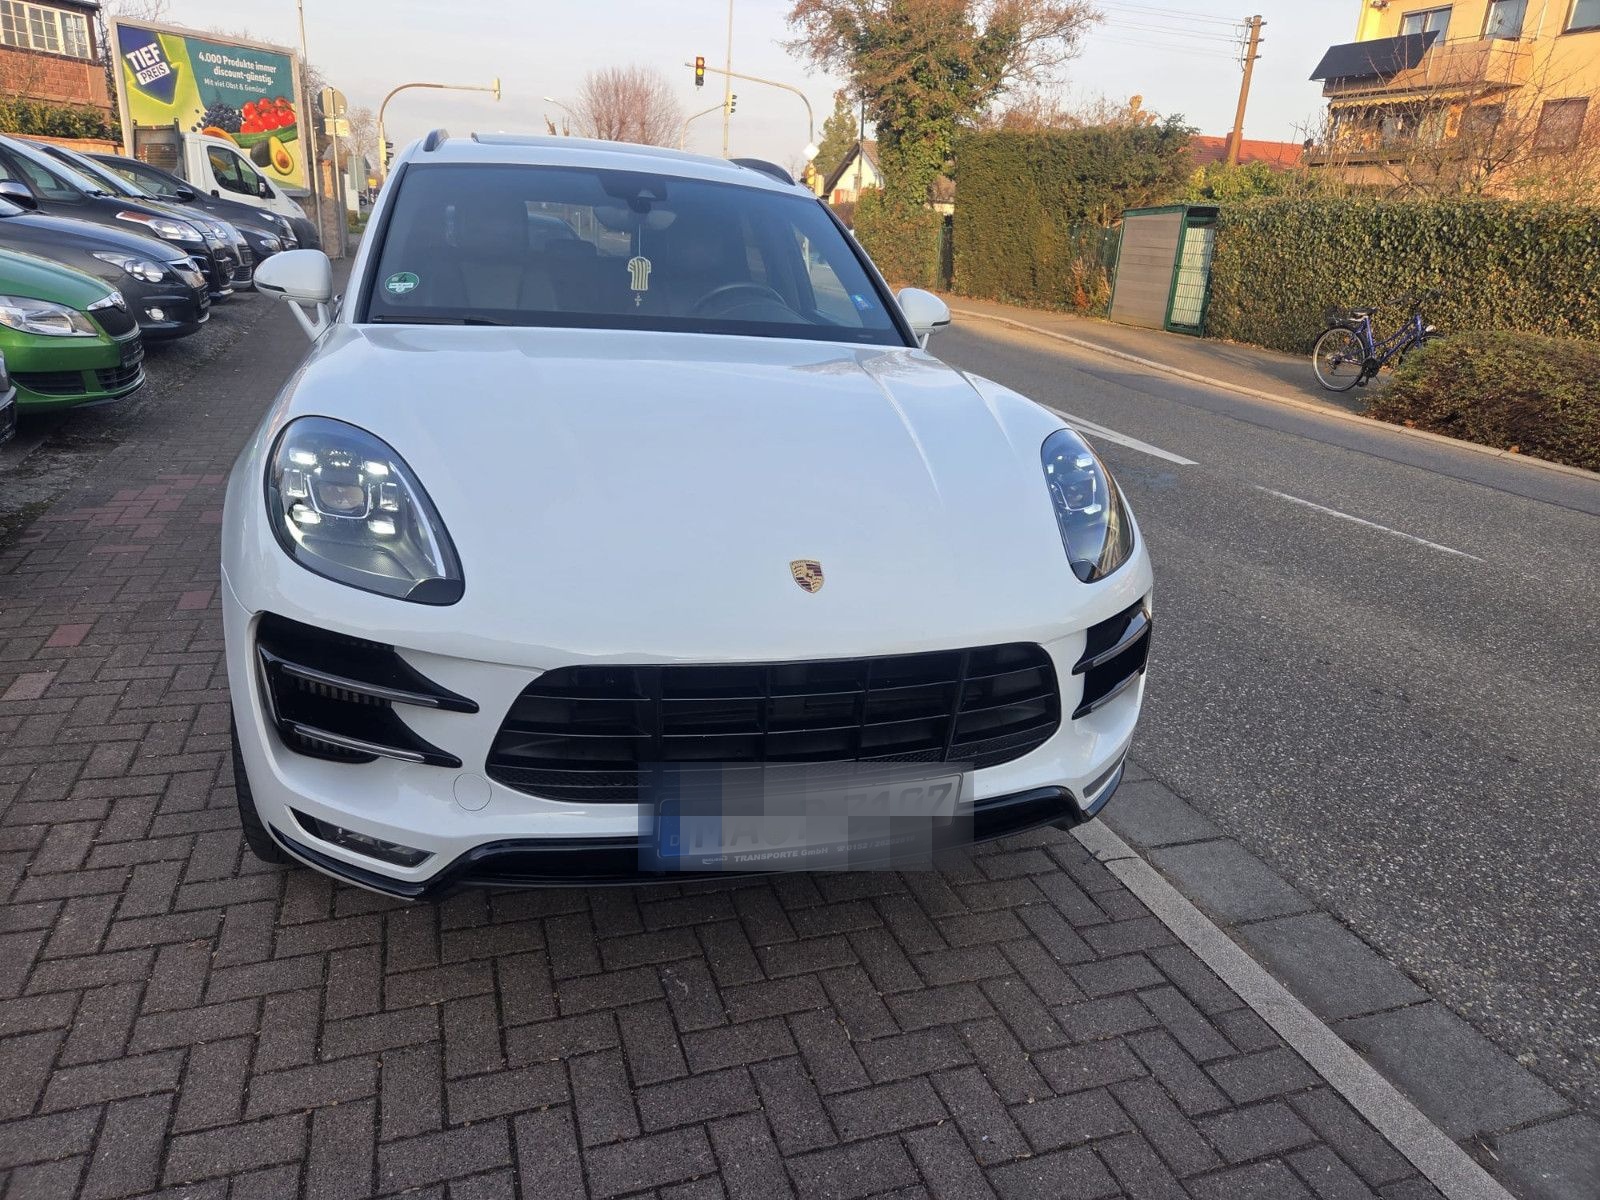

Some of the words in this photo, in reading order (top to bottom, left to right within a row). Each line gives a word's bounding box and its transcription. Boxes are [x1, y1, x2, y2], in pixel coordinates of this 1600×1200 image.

[125, 42, 160, 71] TIEF
[198, 51, 222, 64] 4.000
[222, 55, 255, 70] Produkte
[255, 61, 277, 74] immer
[140, 64, 166, 82] PREIS
[213, 66, 274, 86] discount-günstig.
[204, 78, 214, 86] Mit
[225, 81, 238, 90] Obst
[734, 850, 799, 863] TRANSPORTE
[800, 847, 829, 857] GmbH
